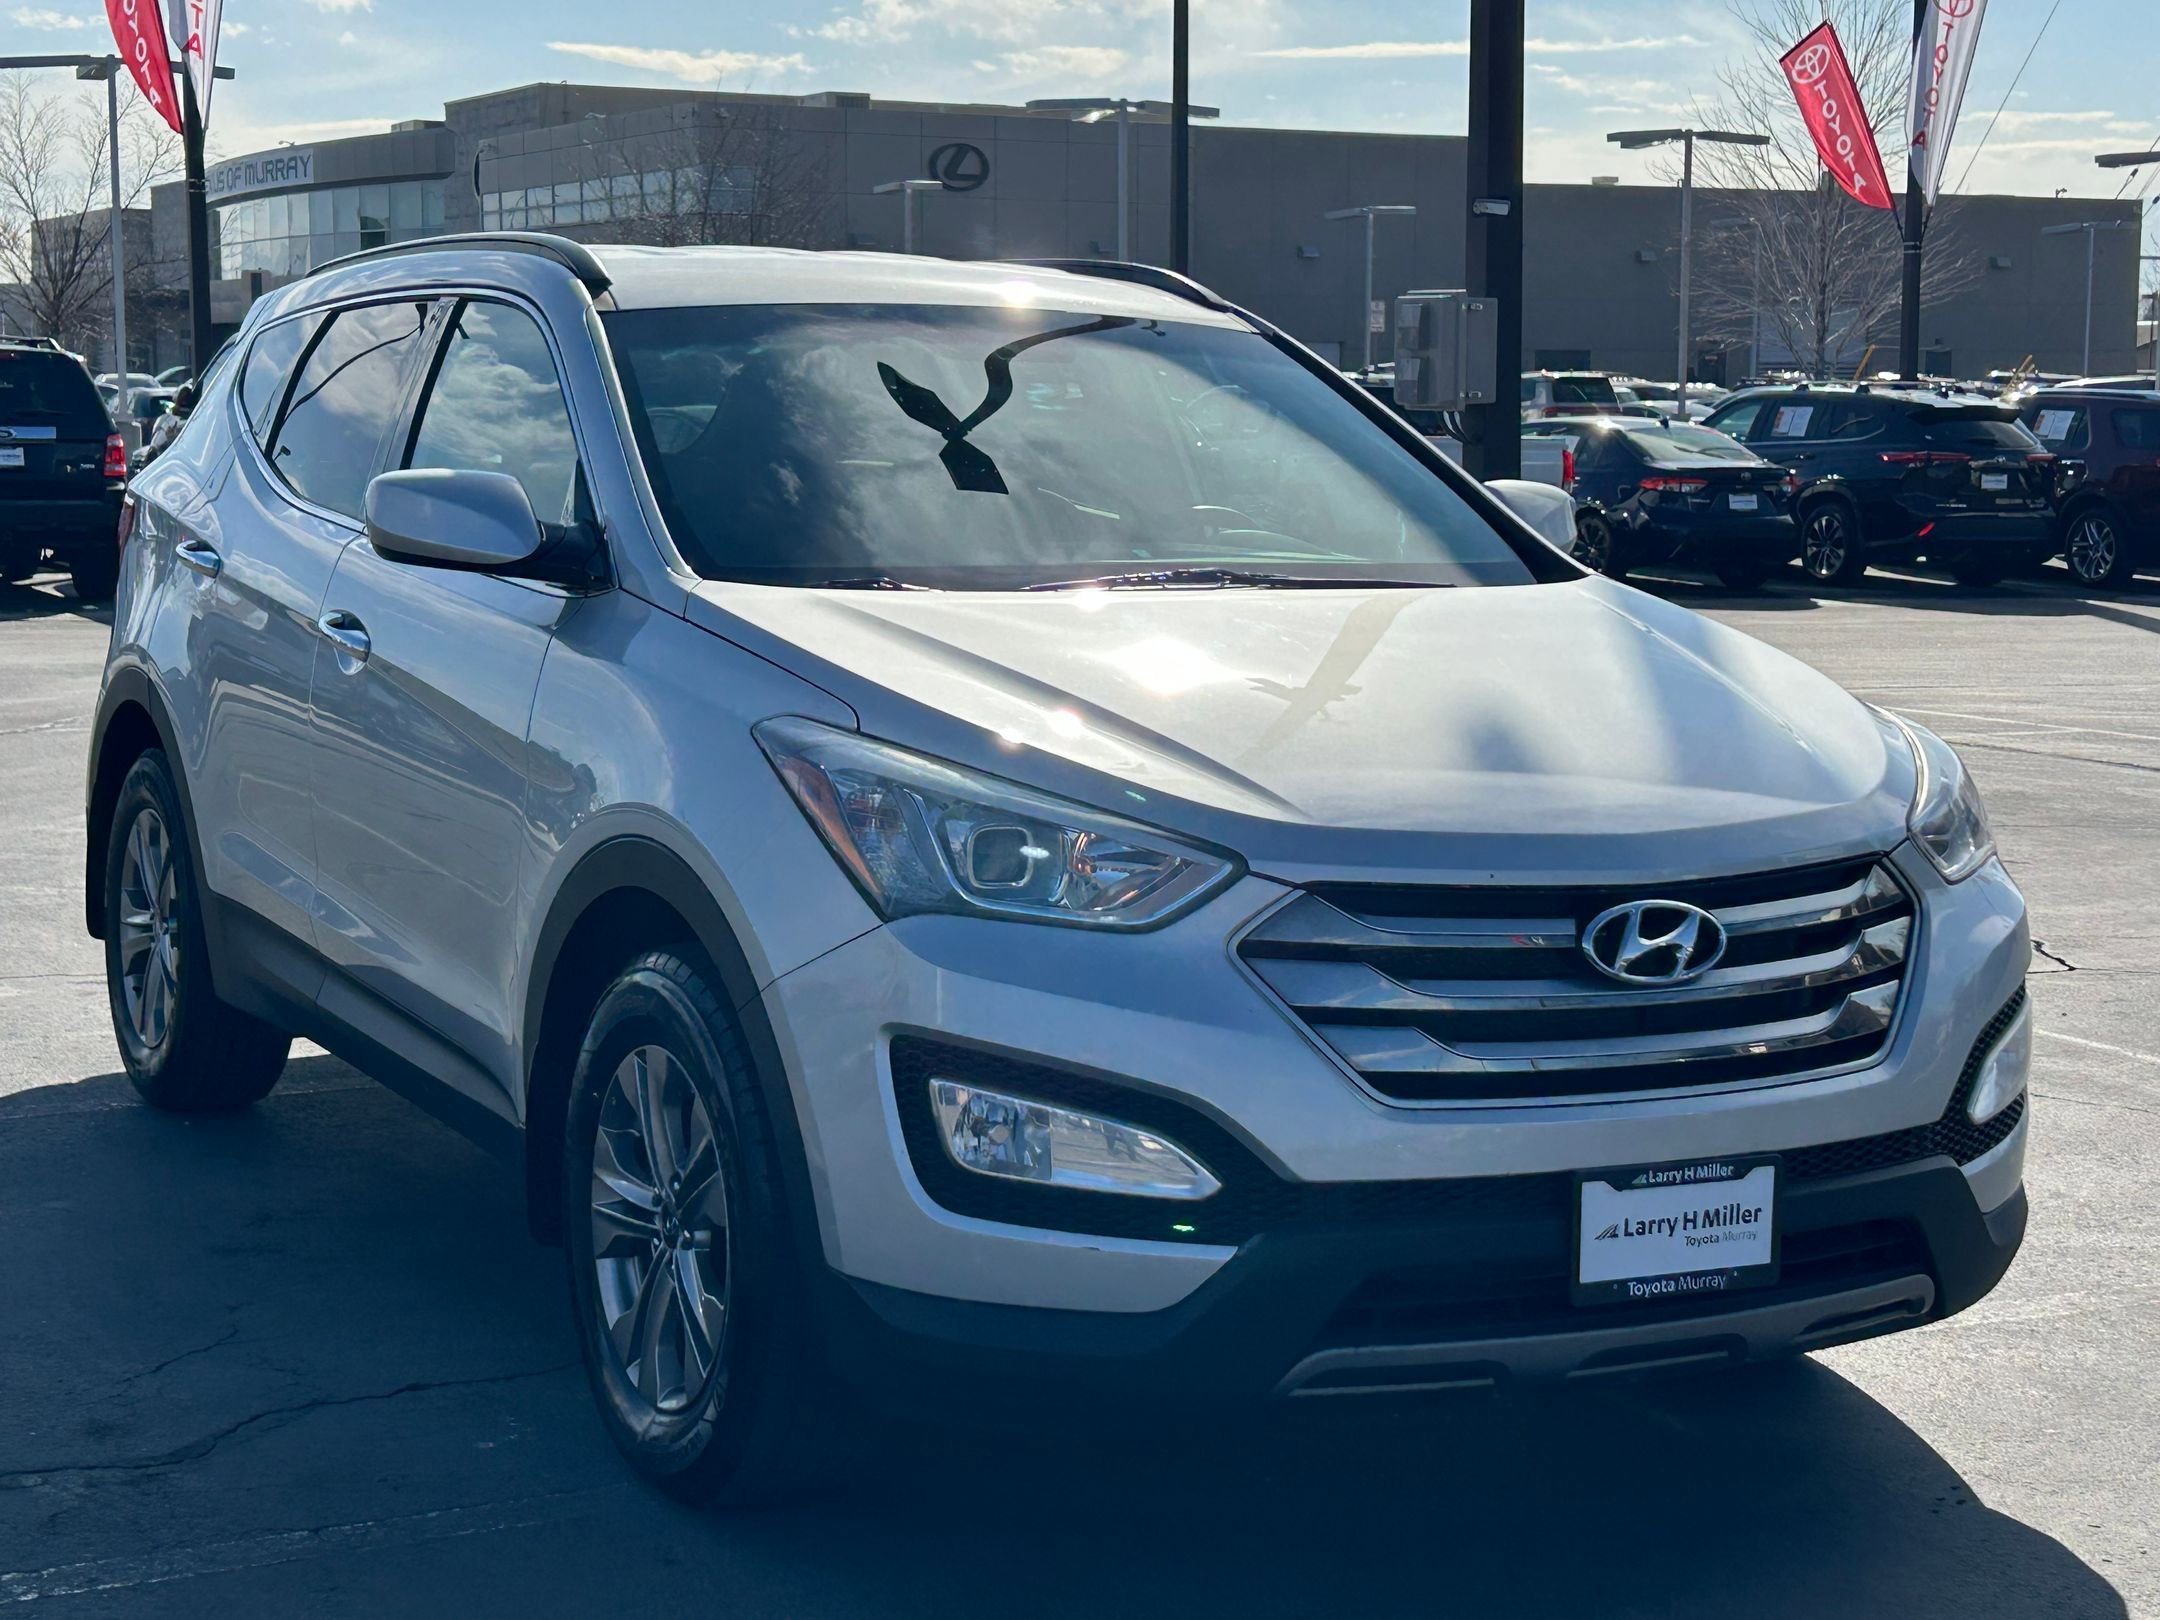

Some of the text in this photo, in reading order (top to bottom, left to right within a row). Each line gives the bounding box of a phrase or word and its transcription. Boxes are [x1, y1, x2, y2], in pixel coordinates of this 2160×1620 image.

[1912, 21, 1953, 150] TOYOTA
[1814, 80, 1866, 193] TOYOTA
[226, 164, 242, 191] OF
[245, 154, 311, 185] MURRAY
[1649, 1163, 1734, 1184] Larry H Miller
[1623, 1203, 1762, 1238] Larry H Miller
[1685, 1230, 1757, 1248] Toyota Murray
[1628, 1274, 1727, 1298] Toyota Murray
